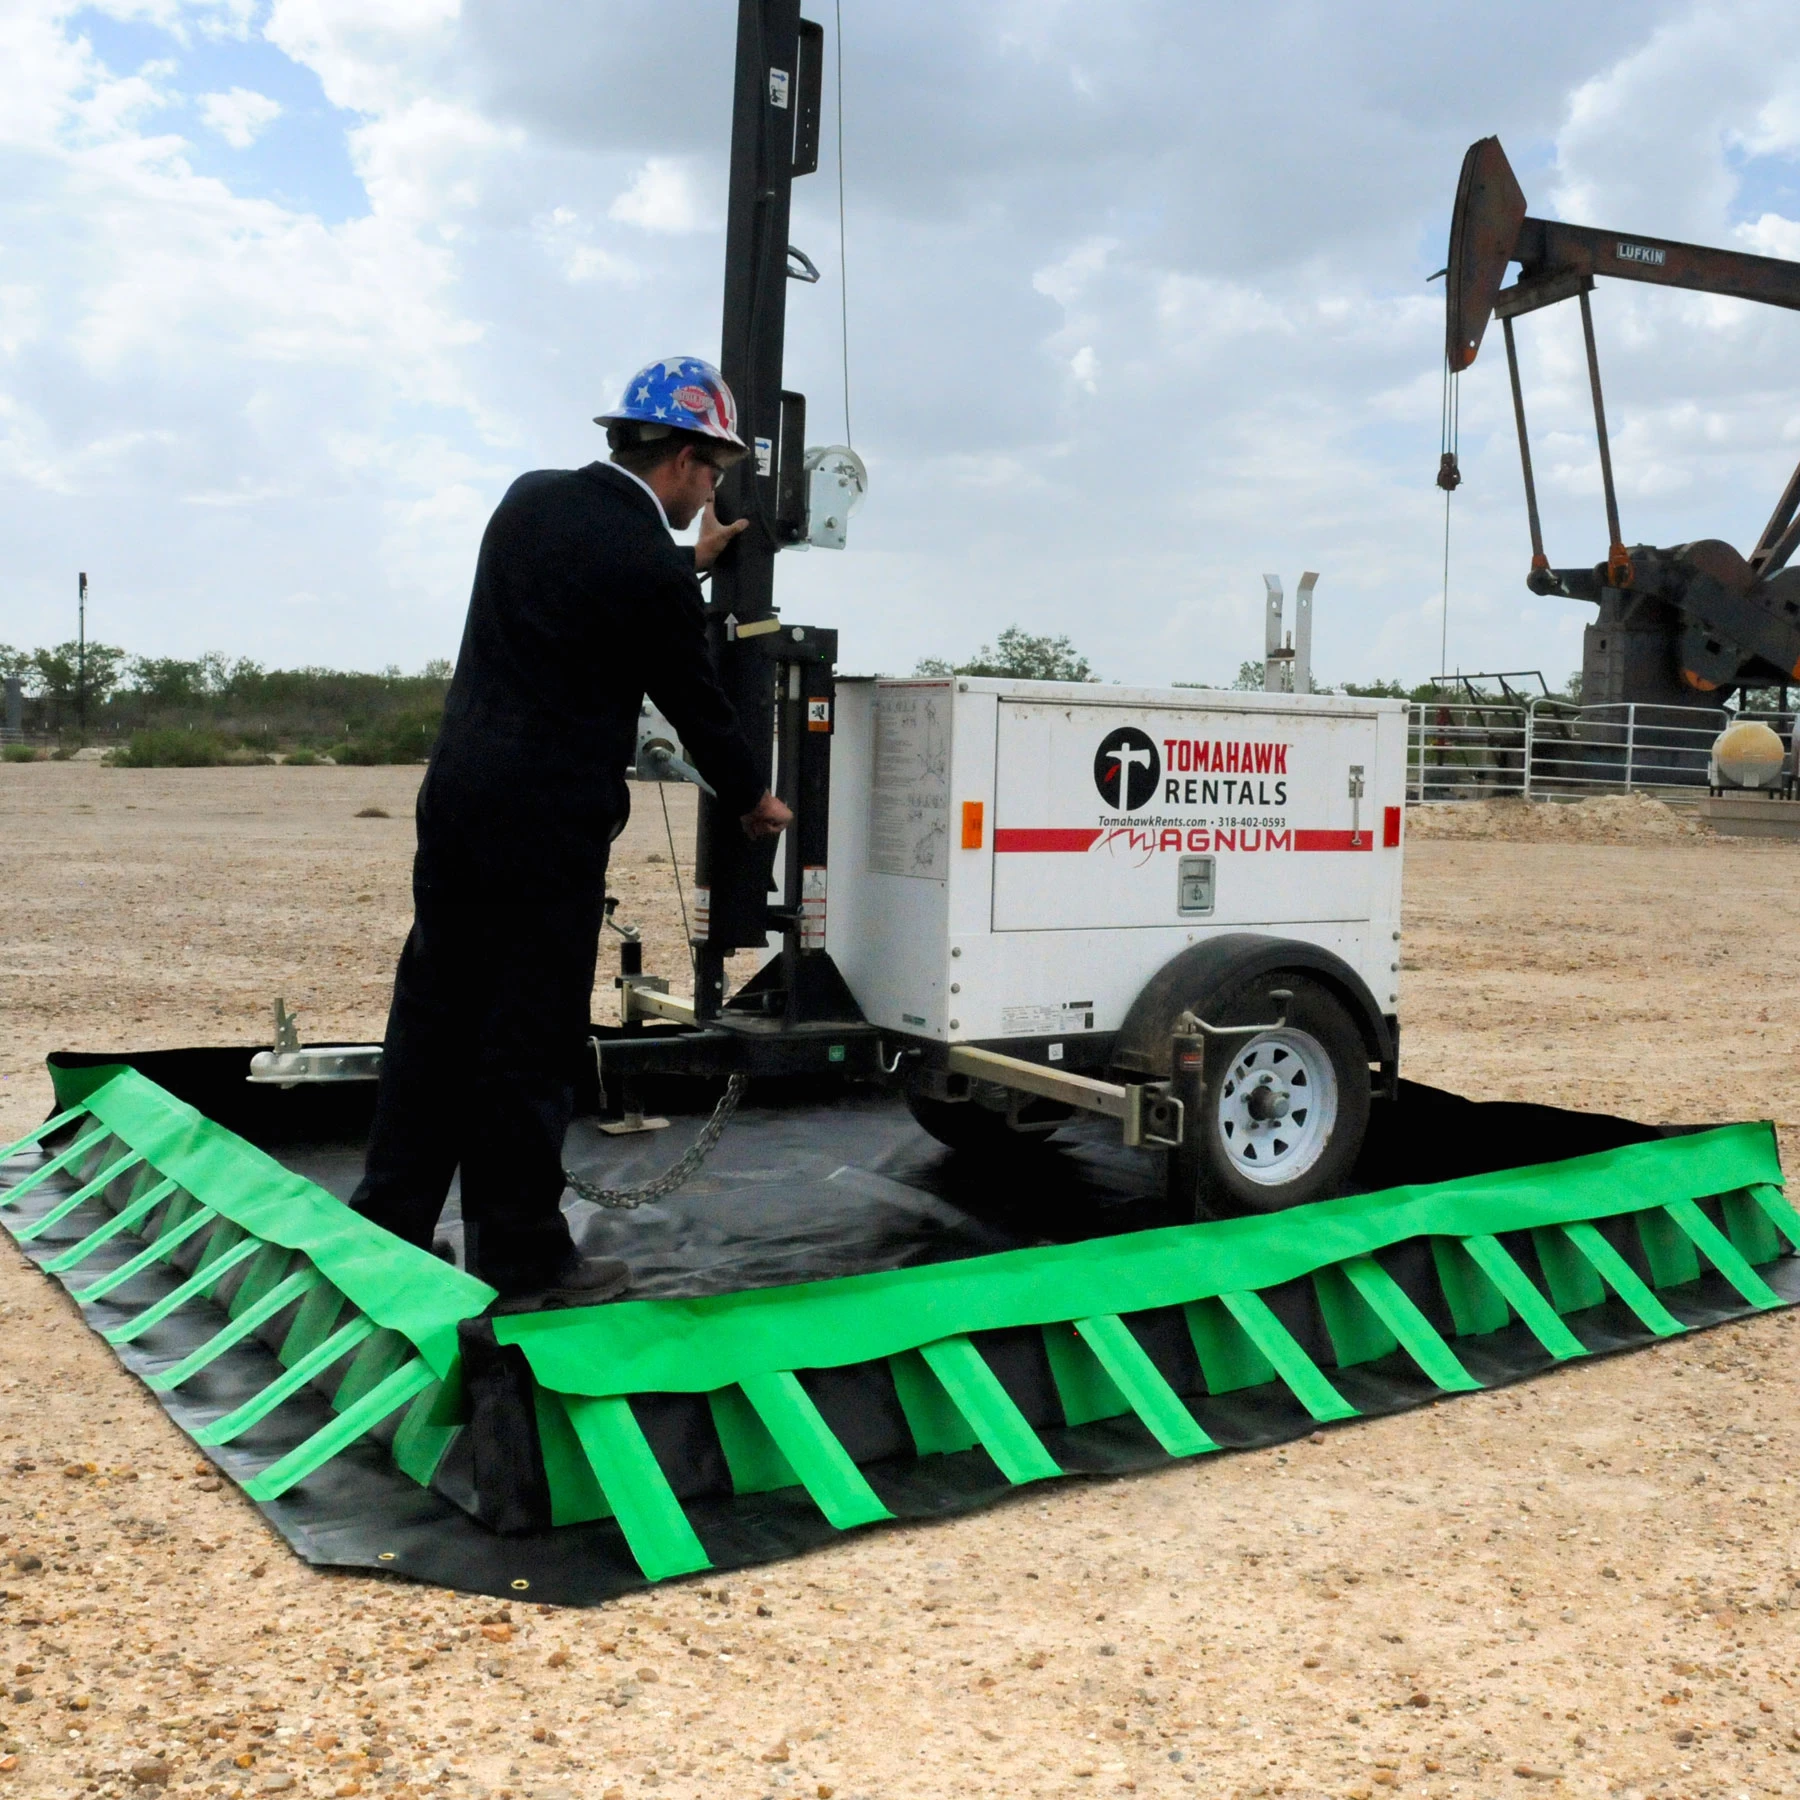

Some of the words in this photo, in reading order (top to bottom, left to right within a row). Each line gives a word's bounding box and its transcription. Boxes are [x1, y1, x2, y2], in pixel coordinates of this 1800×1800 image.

[1619, 244, 1663, 264] LUFKIN
[1164, 739, 1288, 775] TOMAHAWK
[1165, 779, 1287, 806] RENTALS
[1098, 815, 1207, 828] TomahawkRents.com
[1218, 816, 1286, 828] 318-402-0593
[1095, 828, 1292, 868] MAGNUM
